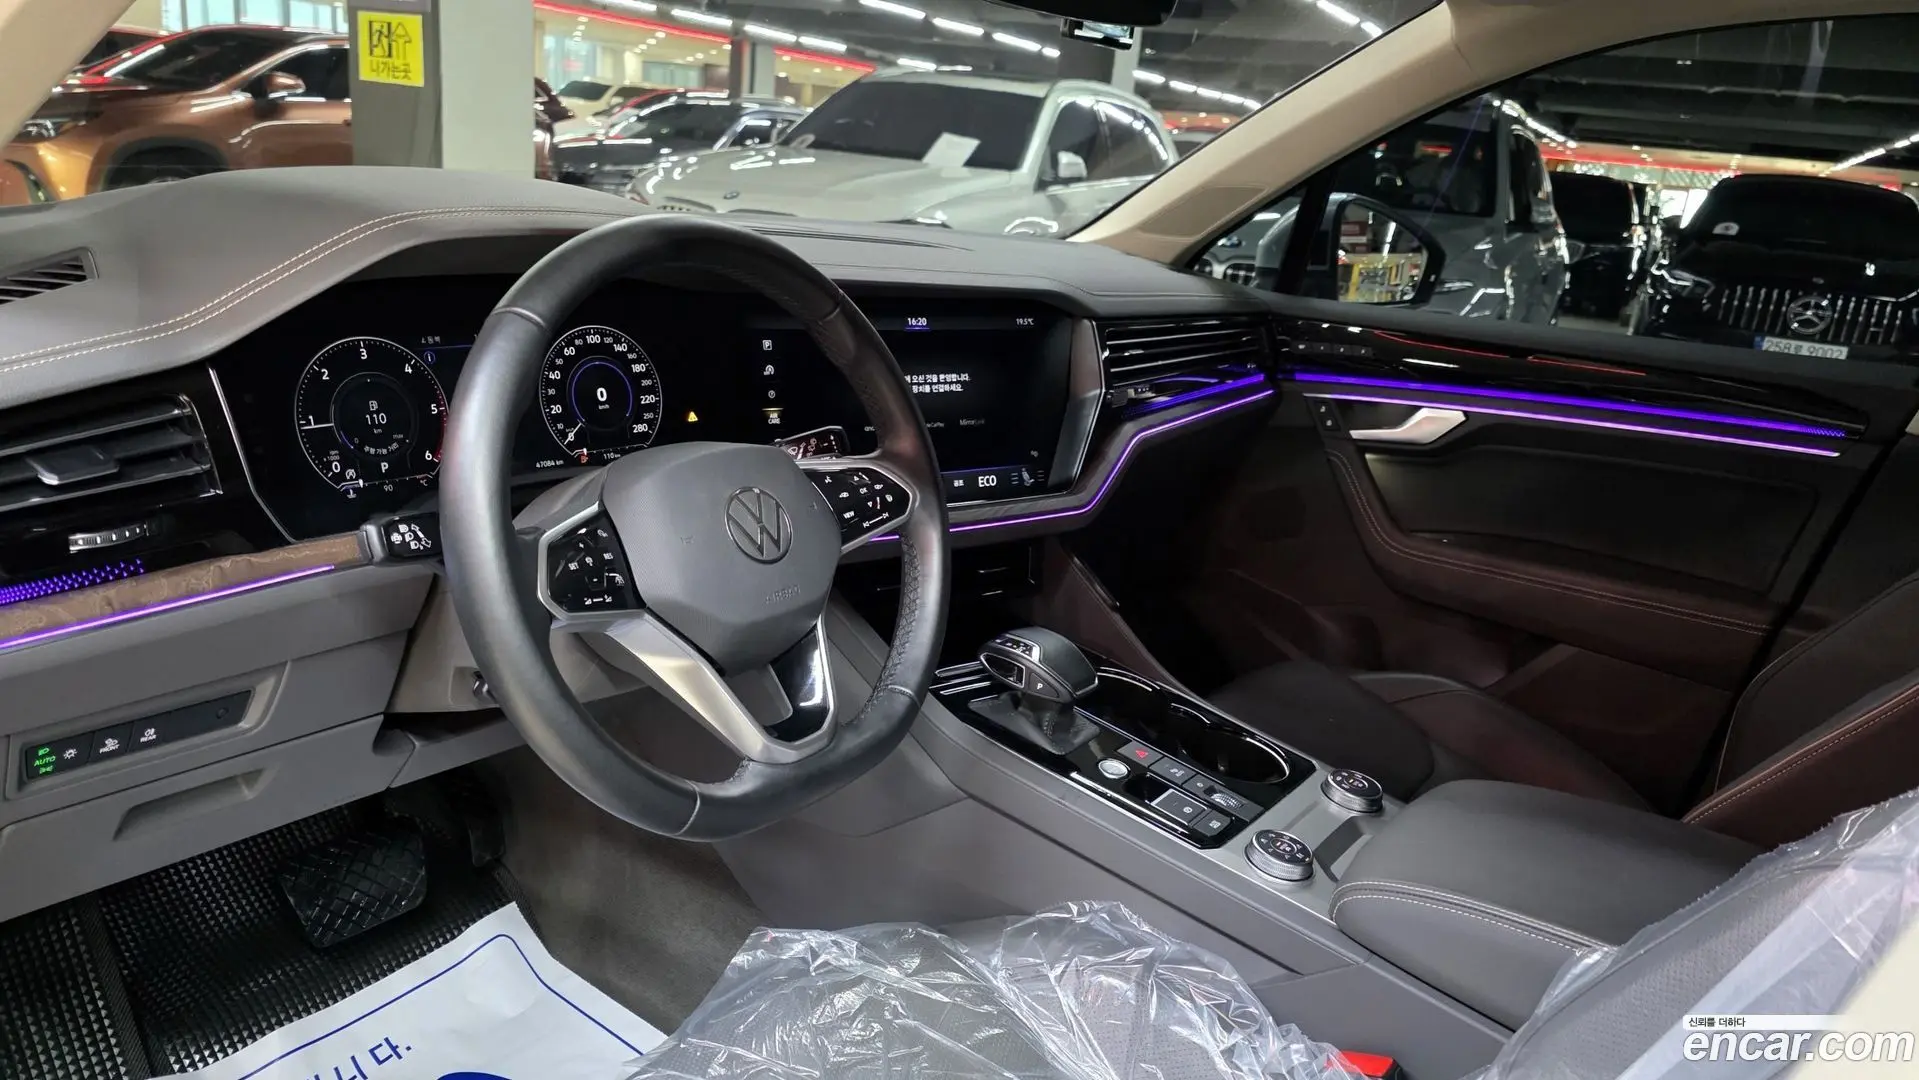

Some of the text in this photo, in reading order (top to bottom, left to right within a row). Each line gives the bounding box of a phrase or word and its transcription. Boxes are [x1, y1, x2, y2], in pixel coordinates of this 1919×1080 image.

[907, 318, 927, 326] 16:20
[575, 337, 583, 345] 80
[586, 335, 600, 344] 100
[564, 347, 575, 356] 60
[613, 343, 627, 352] 140
[360, 348, 368, 360] 3
[404, 364, 412, 374] 4
[631, 364, 646, 372] 180
[321, 369, 330, 380] 2
[549, 371, 560, 380] 40
[596, 387, 607, 402] 0
[640, 395, 655, 404] 220
[430, 404, 438, 414] 5
[550, 405, 562, 414] 20
[308, 415, 314, 426] 1
[366, 413, 387, 424] 110
[632, 424, 648, 433] 280
[425, 450, 432, 460] 6
[332, 461, 341, 473] 0
[380, 462, 388, 473] P
[978, 475, 997, 488] ECO
[383, 484, 393, 492] 90
[1036, 682, 1044, 690] P
[140, 734, 157, 743] REAR
[100, 744, 120, 754] FRONT
[34, 756, 56, 767] AUTO
